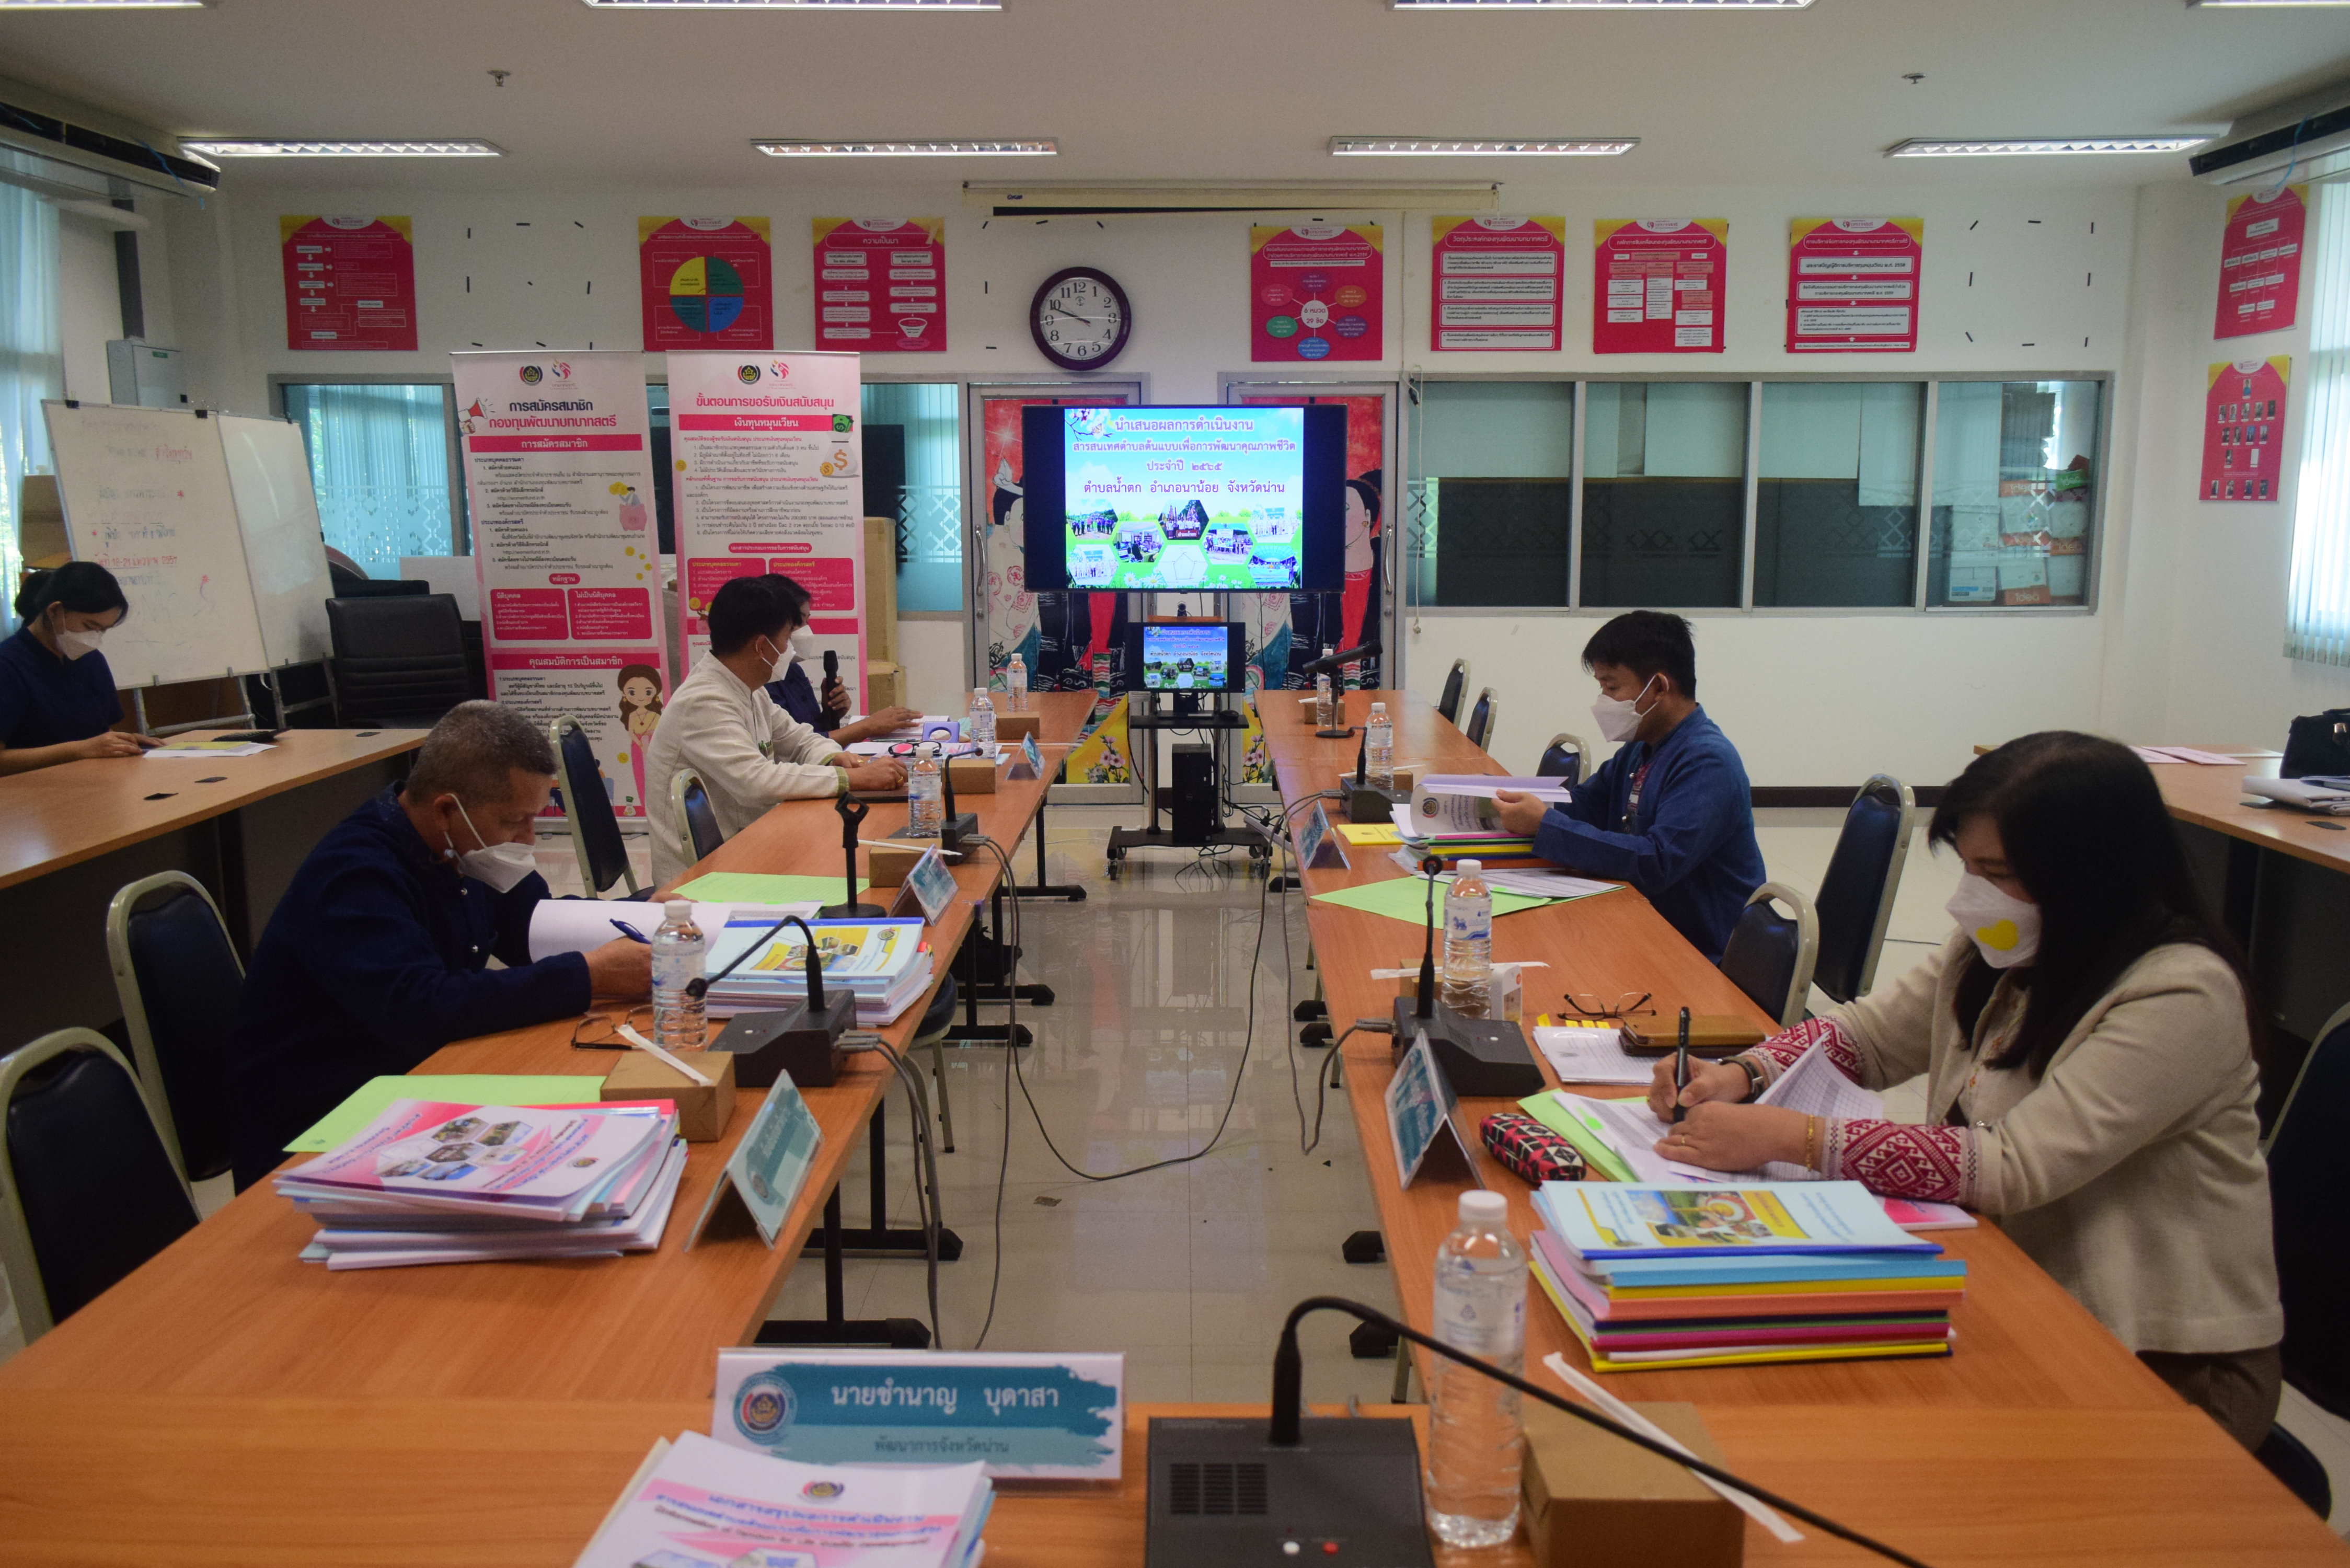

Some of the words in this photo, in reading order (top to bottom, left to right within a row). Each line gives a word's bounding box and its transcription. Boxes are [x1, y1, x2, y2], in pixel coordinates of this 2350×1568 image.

[863, 236, 898, 245] ความเป็นมา
[1062, 287, 1071, 298] 11
[1073, 282, 1086, 293] 12
[1093, 286, 1097, 297] 1
[1050, 299, 1061, 310] 10
[1104, 297, 1111, 308] 2
[1045, 315, 1054, 326] 9
[1108, 313, 1117, 324] 3
[1050, 330, 1059, 341] 8
[1103, 329, 1111, 339] 4
[1064, 343, 1072, 353] 7
[1077, 345, 1087, 356] 6
[1092, 342, 1101, 352] 5
[509, 399, 593, 412] การสมัครสมาชิก
[696, 393, 834, 410] ขั้นตอนการขอรับเงินสนับสนุน
[489, 414, 617, 430] กองทุนพัฒนาบทบาทสตรี
[734, 417, 799, 430] เงินทุนหมุนเวียน
[1115, 417, 1254, 431] นำเสนอผลการดำเนินงาน
[522, 438, 588, 448] การสมัครสมาชิก
[1073, 439, 1296, 455] สารสนเทศตำบลต้นแบบเพื่อการพัฒนาคุณภาพชีวิต
[1146, 459, 1184, 472] ประจำปี
[1191, 462, 1223, 472] ๒๕๖๕
[1084, 476, 1142, 494] ตำบลน้ำตก
[1150, 479, 1219, 493] อำเภอนาน้อย
[1227, 479, 1285, 494] จังหวัดน่าน
[575, 591, 616, 600] ไม่เป็นนิติบุคคล
[2015, 592, 2039, 602] idea
[529, 656, 623, 669] คุณสมบัติการเป็นสมาชิก
[831, 1377, 958, 1415] นายชำนาญ
[874, 1435, 1009, 1454] พัฒนาการจังหวัดน่าน
